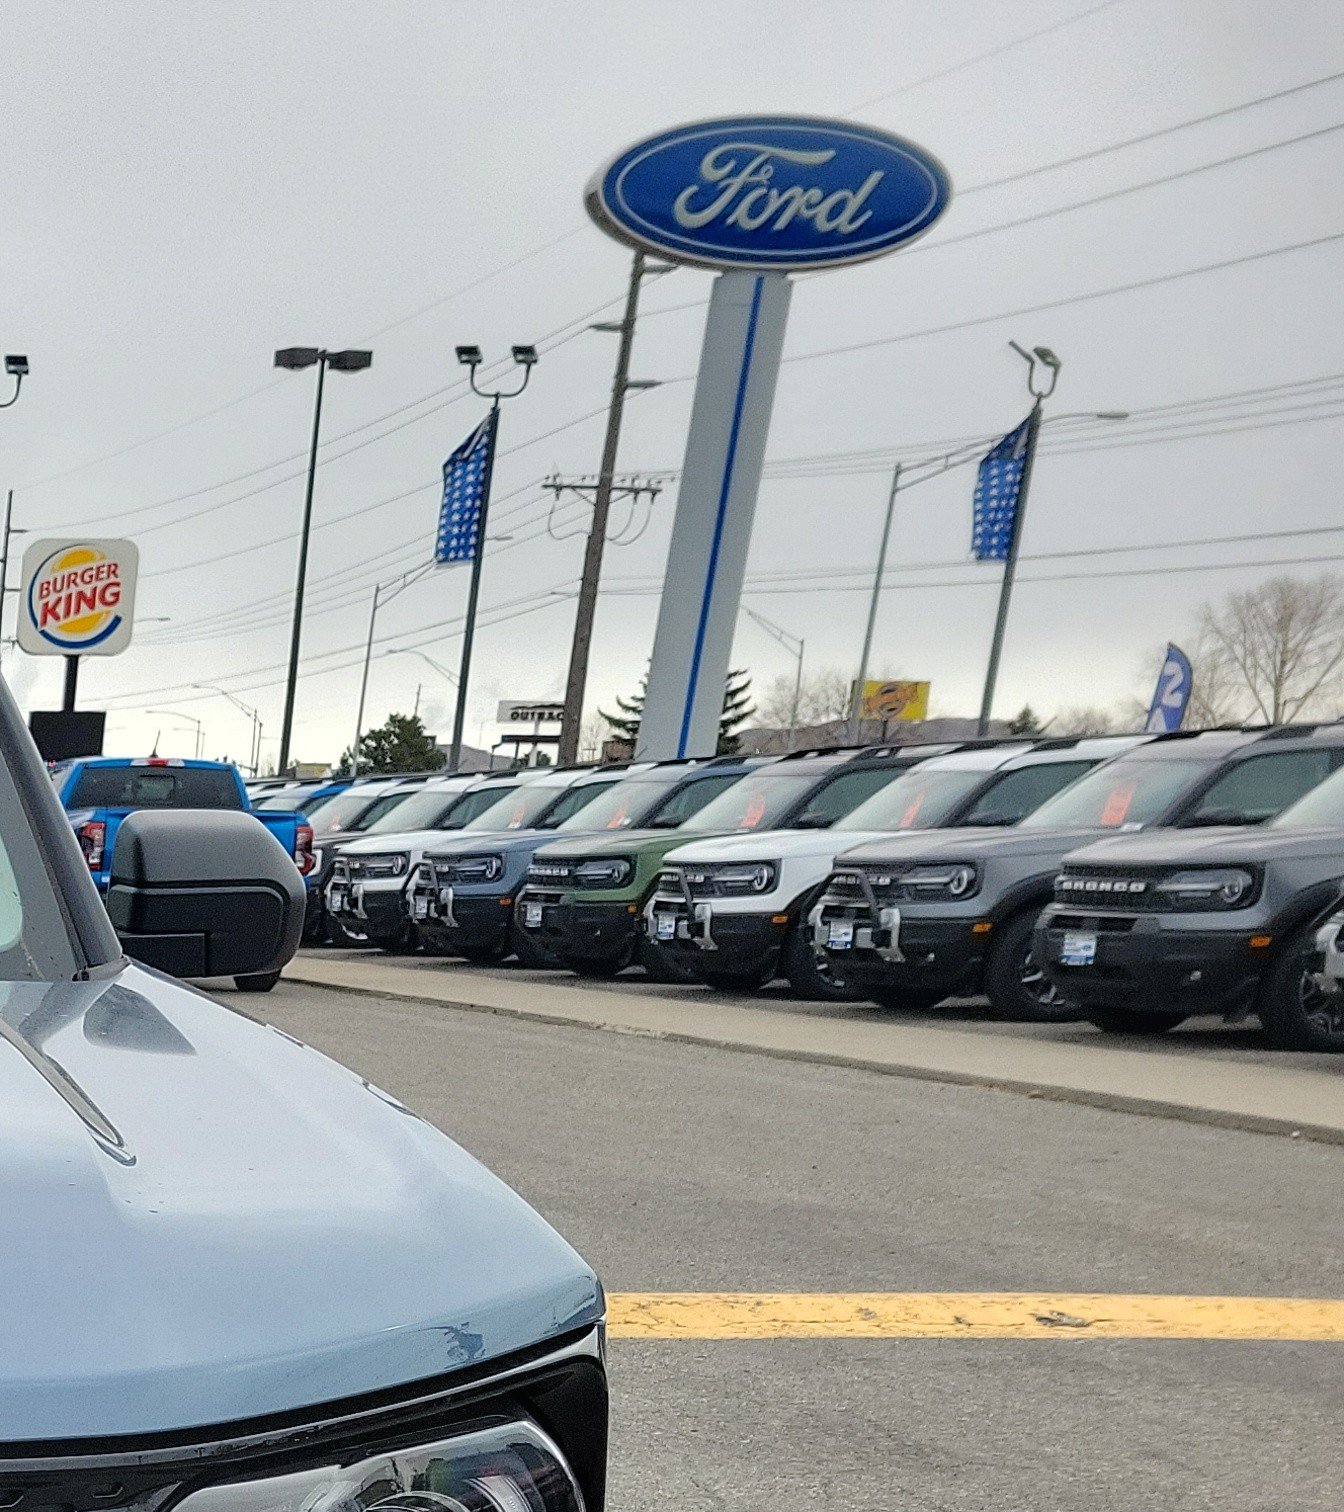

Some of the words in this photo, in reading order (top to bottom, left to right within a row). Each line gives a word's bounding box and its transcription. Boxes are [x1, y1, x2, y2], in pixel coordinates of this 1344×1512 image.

[672, 142, 885, 236] Ford
[38, 562, 120, 600] BURGER
[39, 581, 122, 628] KING
[510, 711, 564, 721] OUTBAC
